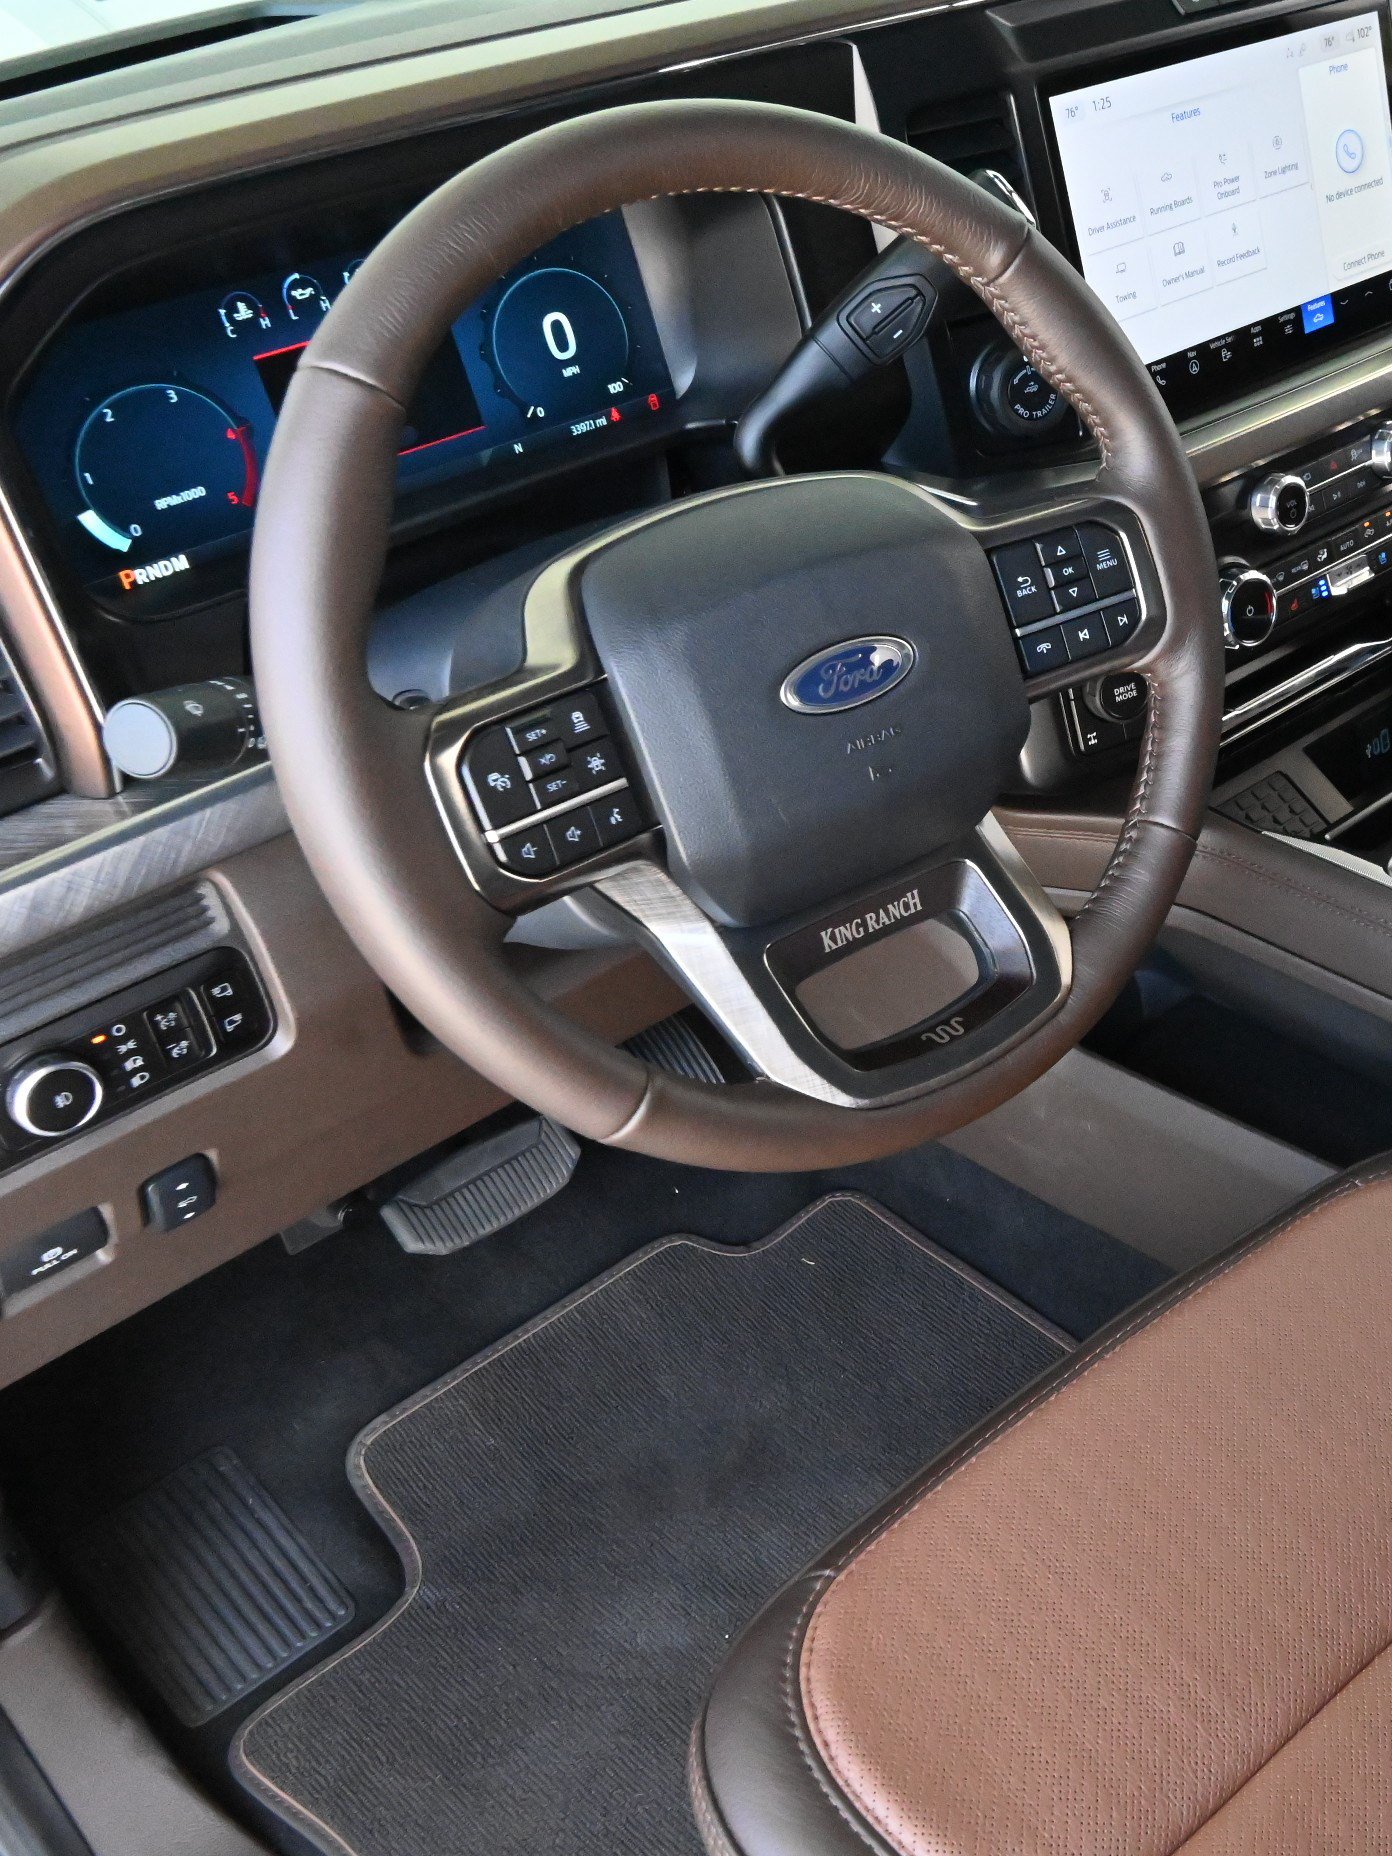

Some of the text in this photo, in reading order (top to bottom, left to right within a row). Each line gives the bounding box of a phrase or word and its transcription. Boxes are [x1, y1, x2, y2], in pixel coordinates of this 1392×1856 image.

[1328, 63, 1349, 75] Phone
[1092, 97, 1112, 111] 1:25
[1065, 106, 1079, 119] 76°
[1171, 107, 1201, 123] Features
[1264, 162, 1299, 179] Zone Lighting
[1213, 175, 1240, 188] Pro Power
[1216, 186, 1241, 200] Onboard
[1325, 177, 1384, 203] No device connected
[1150, 195, 1193, 216] Running Boards
[1087, 214, 1137, 236] Driver Assistance
[1216, 246, 1261, 267] Record Feedback
[1343, 250, 1385, 271] Connect Phone
[1162, 266, 1206, 287] Owner's Manual
[1115, 290, 1137, 304] Towing
[1307, 299, 1326, 311] Features
[260, 316, 272, 329] H
[226, 326, 237, 338] C
[542, 311, 577, 360] 0
[1209, 339, 1226, 349] Vehicle
[561, 365, 581, 377] MPH
[1151, 361, 1167, 373] Phone
[607, 381, 624, 394] 100
[165, 389, 178, 403] 3
[536, 406, 545, 418] 0
[1013, 393, 1057, 418] PRO TRAILER
[102, 408, 114, 422] 2
[595, 415, 608, 428] mi
[513, 442, 523, 454] N
[83, 472, 94, 485] 1
[227, 491, 239, 504] 5
[129, 524, 142, 537] 0
[1340, 540, 1354, 551] AUTO
[1062, 566, 1075, 576] OK
[1096, 558, 1118, 571] MENU
[1016, 585, 1037, 598] BACK
[818, 652, 882, 698] Ford
[1113, 682, 1137, 696] DRIVE
[1115, 690, 1138, 703] MODE
[819, 889, 922, 953] KING RANCH
